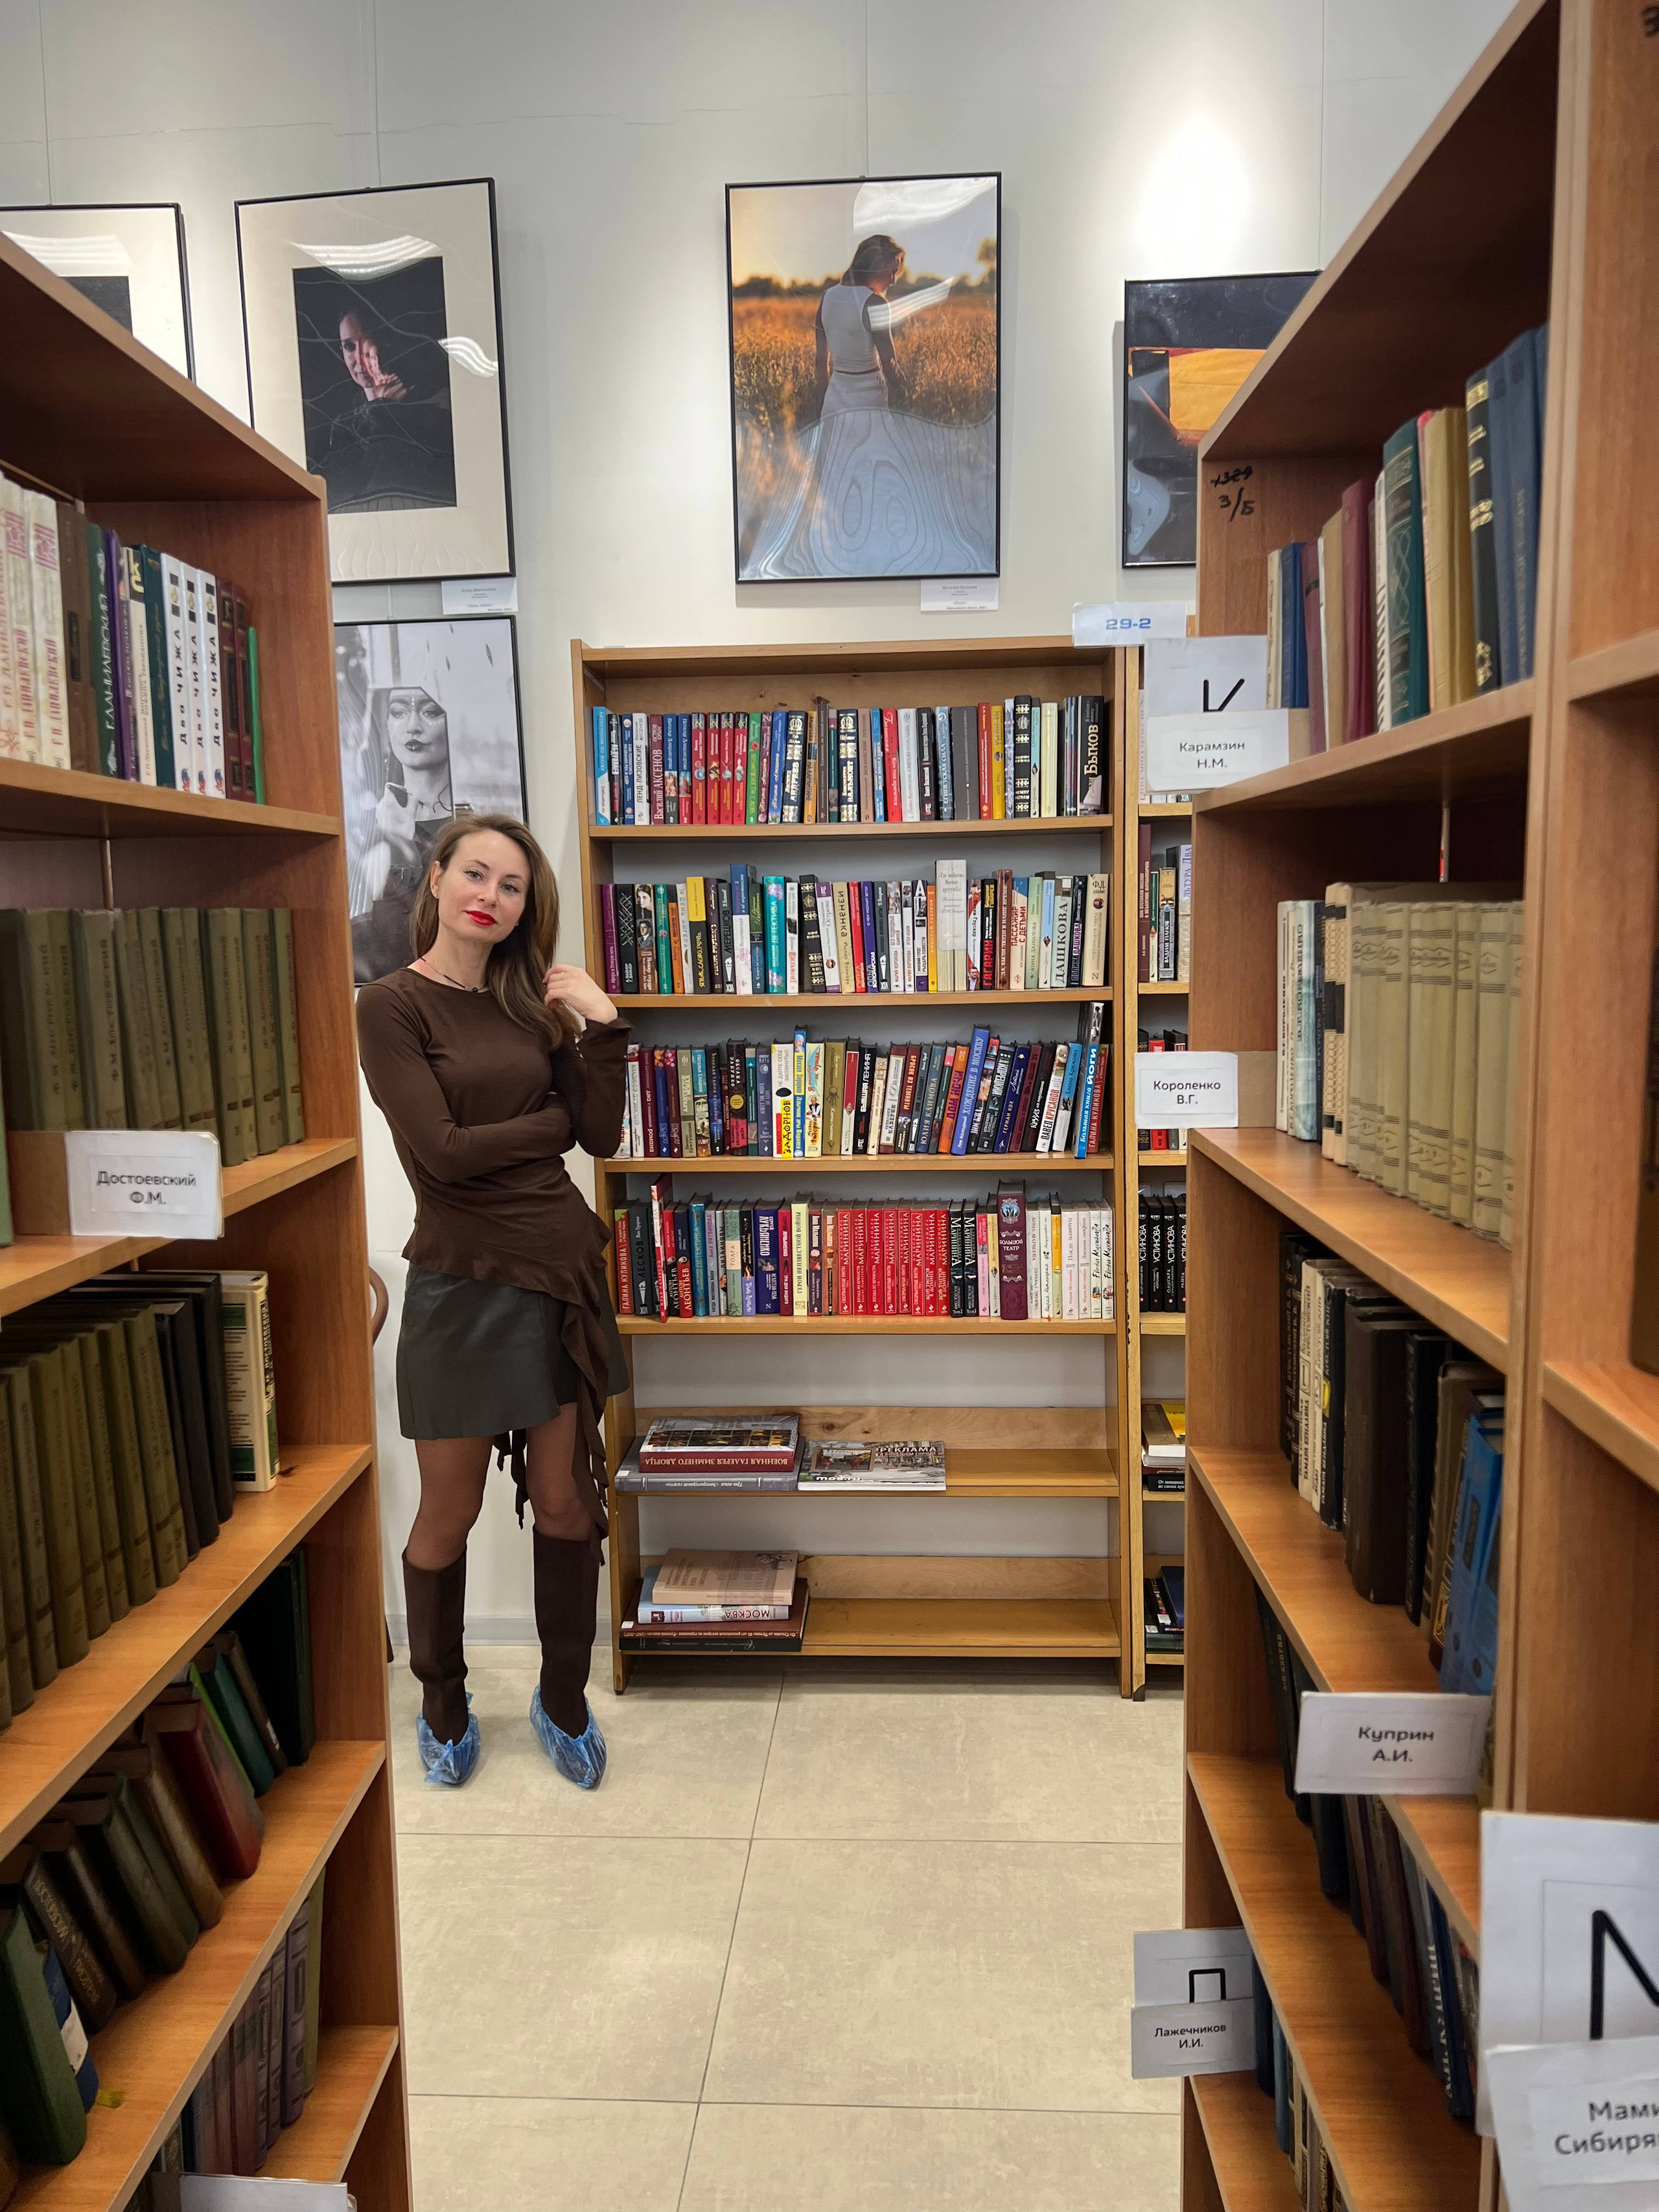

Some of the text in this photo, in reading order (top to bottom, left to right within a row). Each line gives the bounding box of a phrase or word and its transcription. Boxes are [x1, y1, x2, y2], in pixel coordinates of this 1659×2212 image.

[1105, 618, 1152, 630] 29-2
[174, 629, 183, 693] ЧИЖА
[191, 635, 200, 697] ЧИЖА
[209, 636, 218, 697] ЧИЖА
[1084, 725, 1098, 774] Быков
[1179, 741, 1246, 754] Карамзин
[1197, 758, 1227, 769] Н.М.
[653, 749, 664, 819] Василий АКСЕНОВ
[791, 762, 799, 802] АНДРЕЕВ
[723, 910, 732, 953] МЕРЕЦКОВ
[1055, 903, 1067, 983] ДАШКОВА
[1073, 923, 1082, 955] ДАШКОВА
[983, 940, 993, 986] ГАГАРИН
[962, 1075, 977, 1114] ХОЖДЕНИЕ
[972, 1036, 984, 1065] МОСКВУ
[992, 1064, 1008, 1095] КОРЕЦКИЙ
[1067, 1050, 1078, 1076] Крюкова
[903, 1086, 912, 1110] ТЕМНОТЫ
[947, 1071, 963, 1119] ДОМ НОЧИ
[1080, 1111, 1089, 1143] Большая
[1086, 1049, 1096, 1084] ЙОГИ
[1154, 1080, 1221, 1092] Короленко
[1177, 1095, 1198, 1104] В.Г.
[783, 1100, 791, 1154] ЗАДОРНОВ
[921, 1078, 937, 1144] ЮЛИЯ КЛИМОВА
[1003, 1113, 1011, 1133] ГЕРМАН
[1041, 1089, 1060, 1140] ПАВЕЛ КРУСАНОВ
[1089, 1085, 1100, 1147] ГАЛИНА КУЛИКОВА
[97, 1171, 196, 1186] Достоевский
[129, 1191, 167, 1205] Ф.М.
[759, 1216, 769, 1256] ЛУКЬЯНЕНКО
[951, 1217, 962, 1266] МАРИНИНА
[964, 1217, 976, 1266] МАРИНИНА
[1091, 1223, 1100, 1257] Михайлова
[636, 1241, 645, 1277] ЛЕСКОВ
[682, 1268, 691, 1310] ЛЕОНТЬЕВ
[725, 1610, 770, 1618] МОСКВА
[1358, 1726, 1435, 1743] Куприн
[1372, 1749, 1413, 1762] А.И.
[1154, 2024, 1227, 2037] Лажечников
[1179, 2038, 1204, 2049] И.И.
[1555, 2130, 1659, 2156] Сибиря
